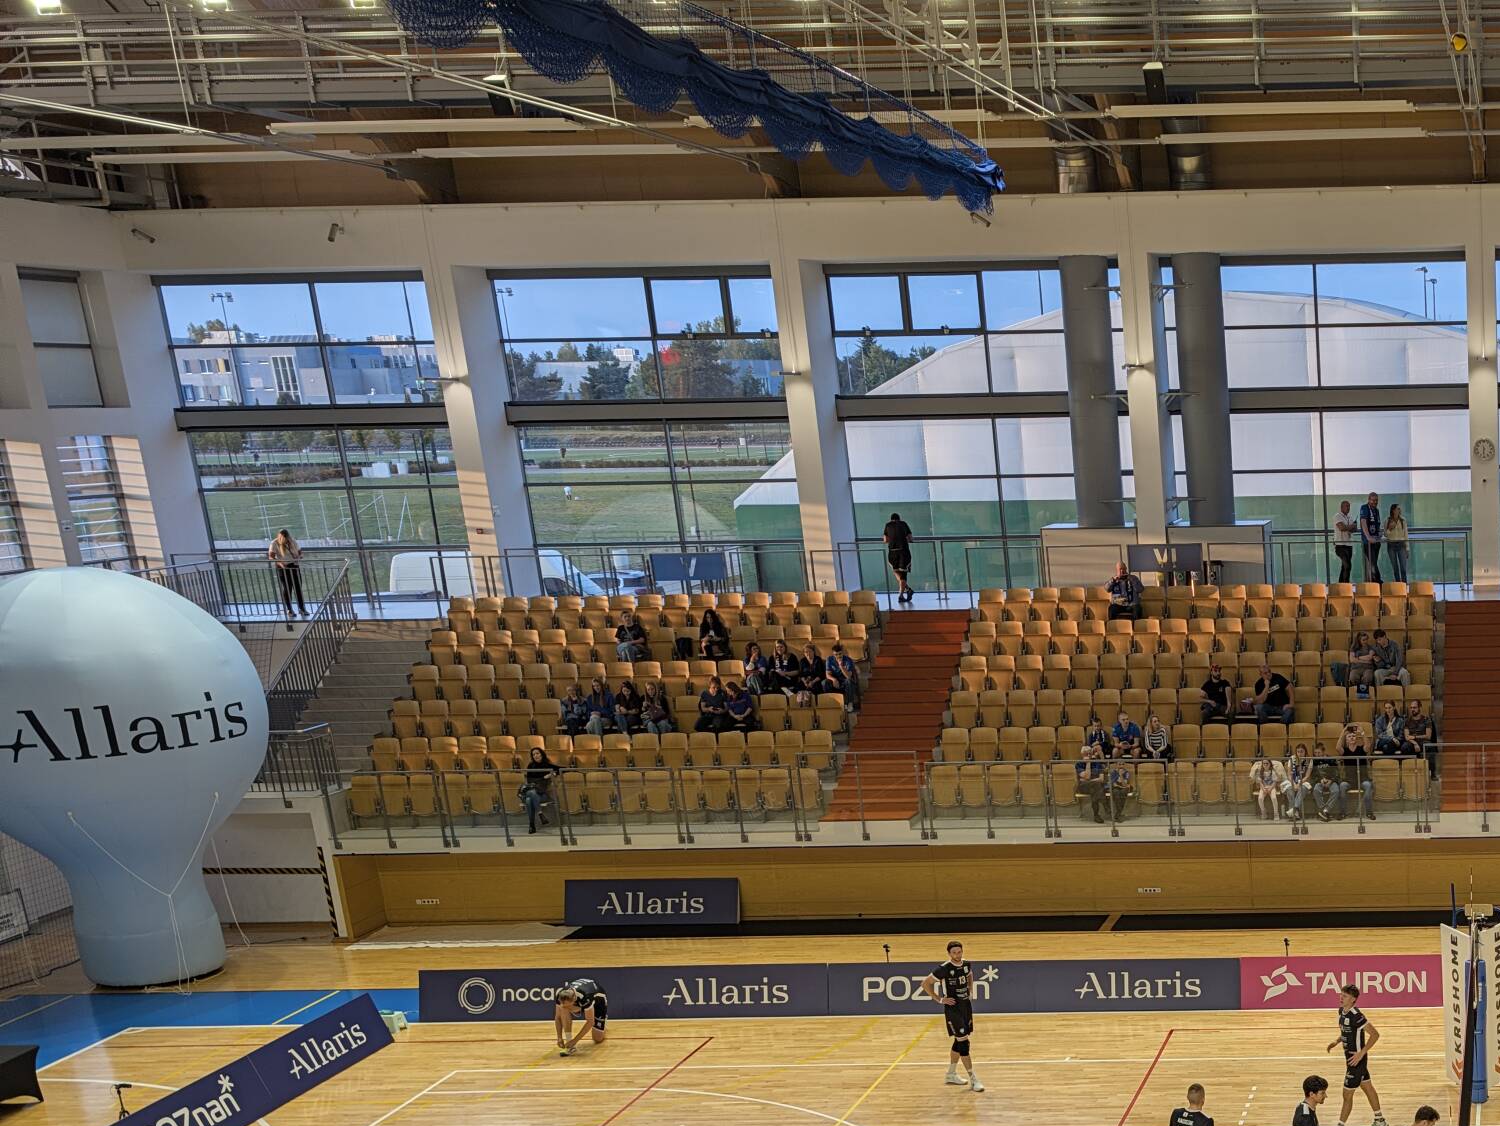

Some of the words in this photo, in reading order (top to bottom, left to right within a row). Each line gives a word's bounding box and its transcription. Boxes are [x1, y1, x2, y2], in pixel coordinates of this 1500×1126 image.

[0, 691, 249, 763] Allaris
[597, 891, 705, 915] Allaris
[662, 977, 789, 1006] Allaris
[1075, 971, 1202, 999] Allaris
[1305, 971, 1428, 995] TAURON
[1450, 933, 1462, 1055] KRISHOME
[287, 1020, 367, 1080] Allaris
